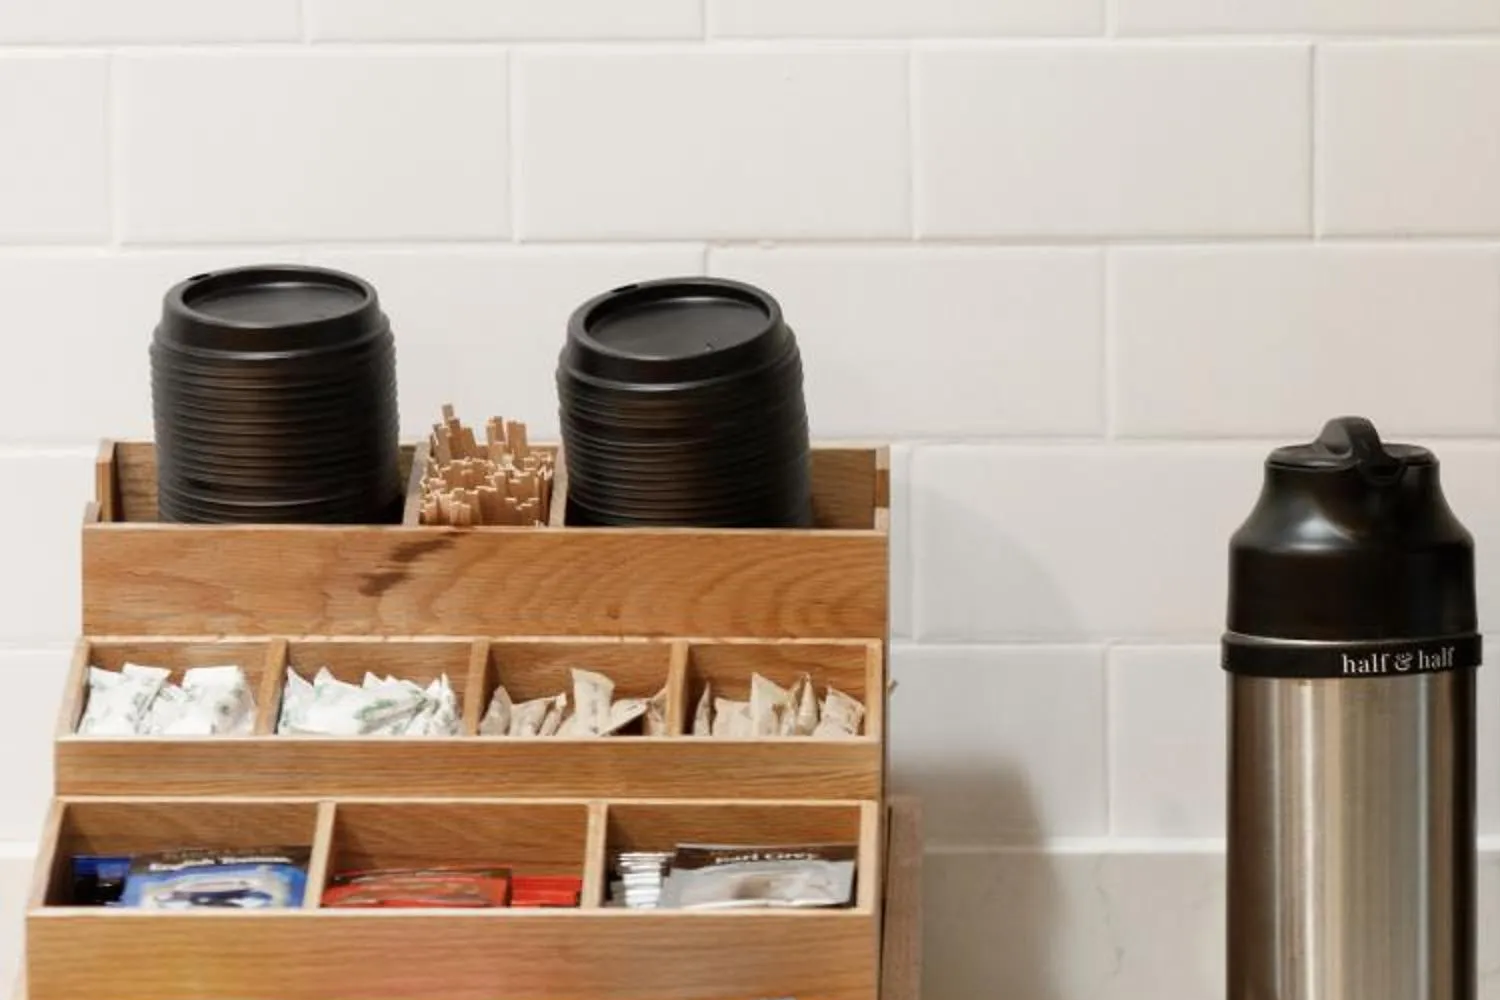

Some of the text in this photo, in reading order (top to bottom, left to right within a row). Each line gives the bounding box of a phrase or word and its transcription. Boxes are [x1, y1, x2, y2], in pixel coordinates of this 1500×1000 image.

[1342, 646, 1455, 673] half & half
